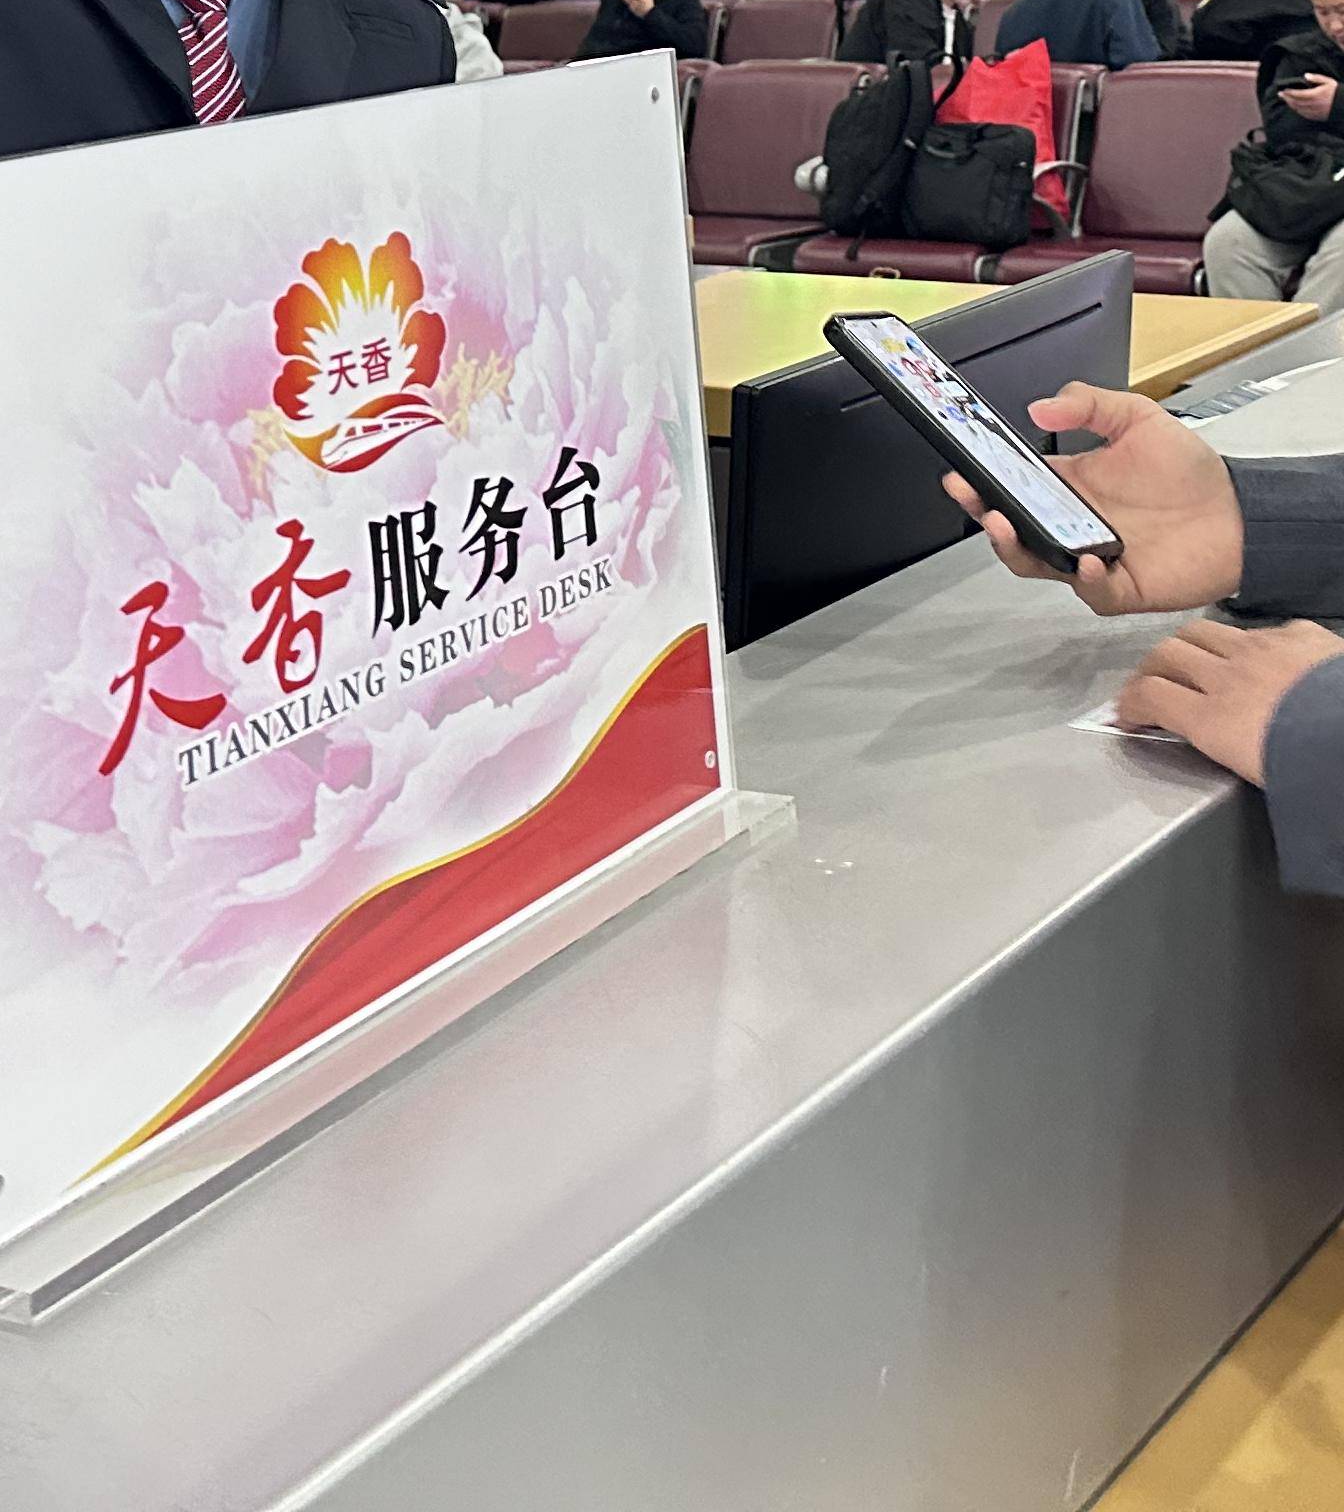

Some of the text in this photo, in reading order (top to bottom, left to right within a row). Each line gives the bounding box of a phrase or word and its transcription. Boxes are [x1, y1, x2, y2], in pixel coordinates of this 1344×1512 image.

[327, 336, 392, 396] 天香
[178, 557, 614, 787] TIANXIANG SERVICE DESK
